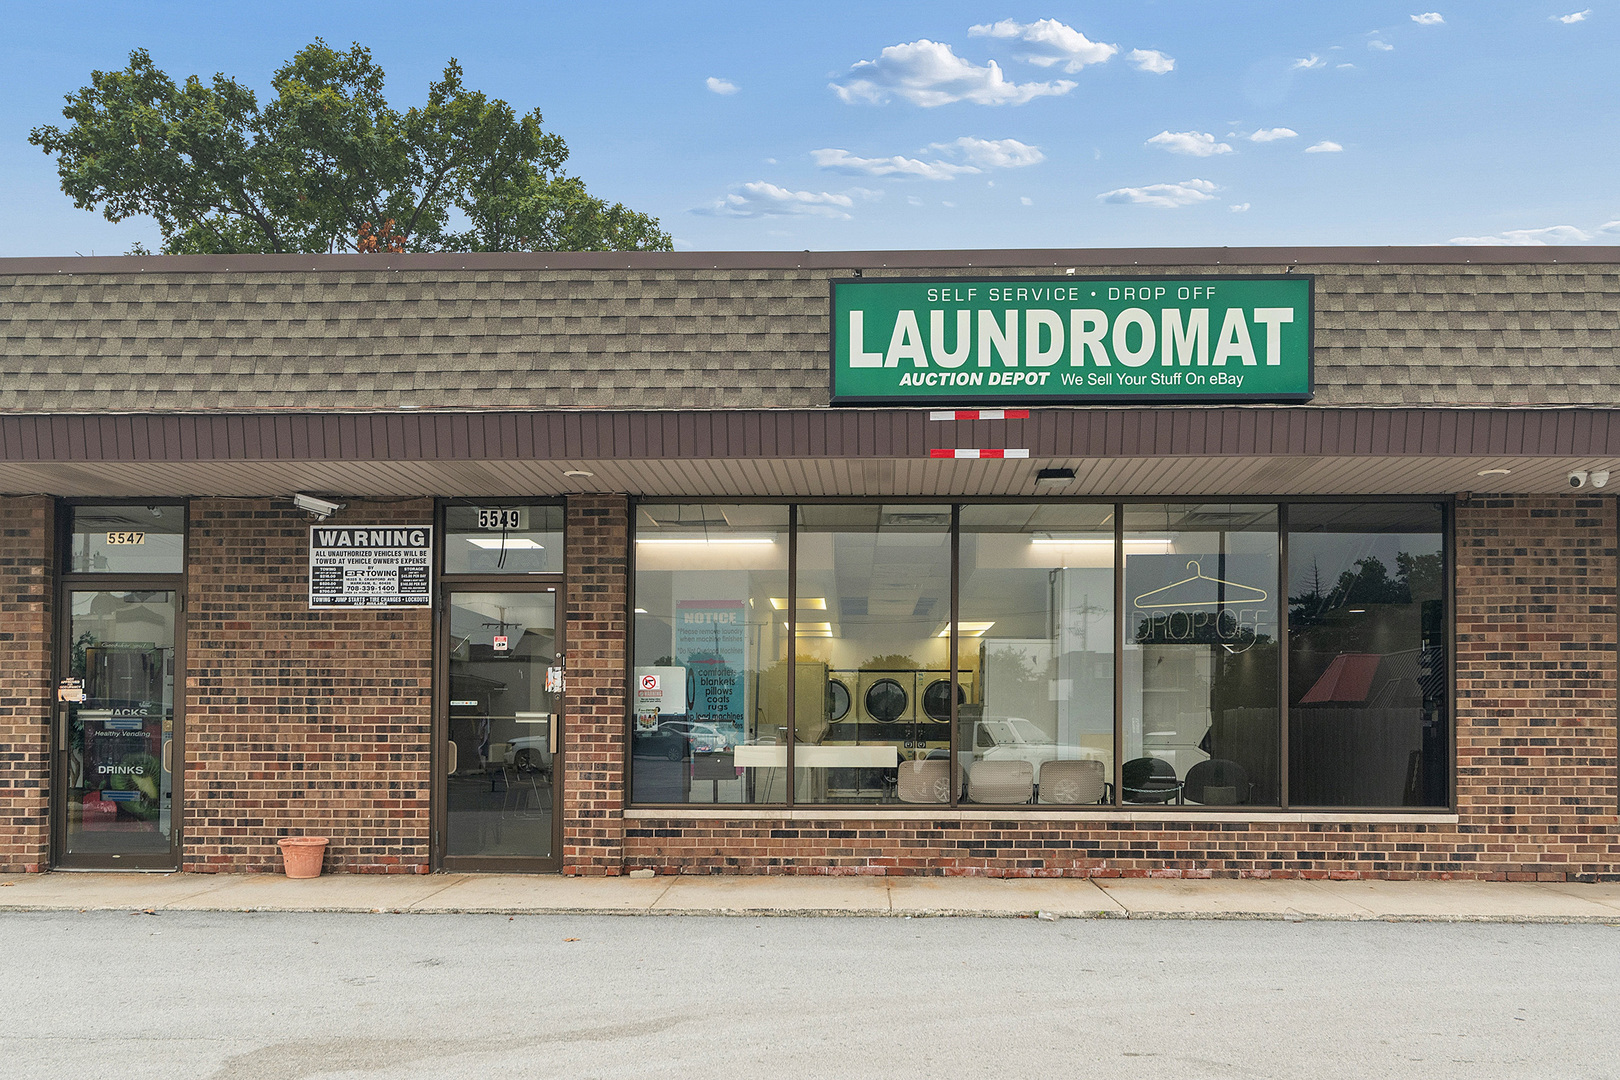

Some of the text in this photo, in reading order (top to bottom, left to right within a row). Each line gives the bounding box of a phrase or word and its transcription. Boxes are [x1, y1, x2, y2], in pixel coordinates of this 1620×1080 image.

[927, 286, 1217, 302] SELF SERVICE DROP OFF
[849, 307, 1294, 369] LAUNDROMAT
[899, 371, 1244, 388] AUCTION DEPOT We Sell Your Stuff On eBay
[479, 510, 519, 527] 5549
[108, 532, 144, 544] 5547
[318, 530, 425, 546] WARNING
[684, 612, 737, 624] NOTICE
[1131, 608, 1268, 640] DROP OFF
[698, 628, 721, 636] remove
[722, 628, 743, 636] laundry
[698, 668, 737, 677] comforters
[700, 677, 736, 686] blankets
[705, 686, 733, 697] pillows
[706, 695, 730, 703] coats
[98, 708, 148, 717] ACKS
[707, 703, 728, 712] rugs
[711, 712, 744, 721] machines
[95, 730, 151, 738] Healthy Vending
[98, 765, 144, 775] DRINKS
